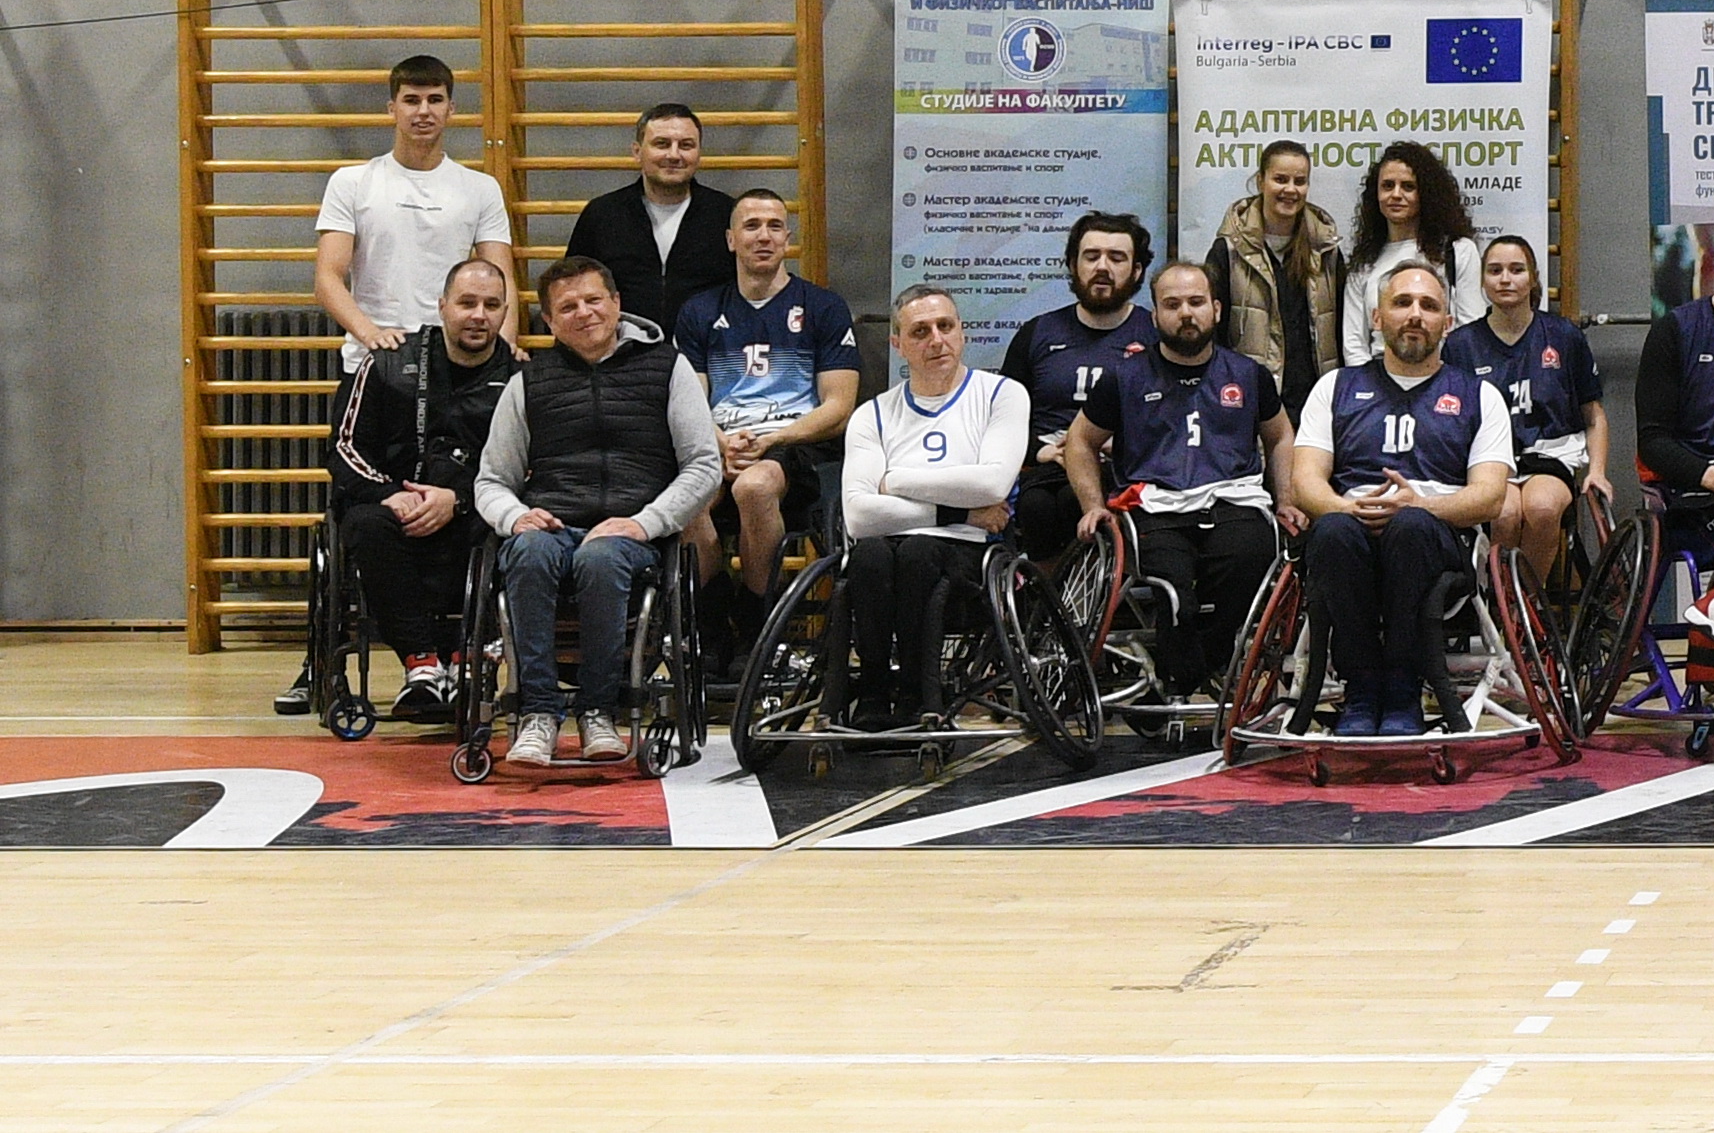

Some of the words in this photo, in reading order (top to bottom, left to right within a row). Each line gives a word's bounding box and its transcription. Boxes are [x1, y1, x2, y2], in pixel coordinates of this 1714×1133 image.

[1197, 35, 1273, 53] Interreg
[1288, 35, 1319, 50] IPA
[1324, 35, 1363, 50] CBC
[1196, 56, 1248, 68] Bulgaria
[1258, 56, 1297, 67] Serbia
[920, 94, 994, 110] СТУДИЈЕ
[998, 95, 1022, 108] НА
[1026, 94, 1126, 109] ФАКУЛТЕТУ
[1194, 109, 1377, 138] АДАПТИВНА
[1386, 107, 1525, 133] ФИЗИЧКА
[925, 147, 980, 159] Основне
[983, 148, 1050, 159] академске
[1053, 148, 1101, 161] студије,
[1195, 142, 1382, 168] АКТНОСТ
[924, 164, 967, 174] физичко
[1034, 164, 1064, 174] спорт
[1464, 176, 1522, 192] МЛАДЕ
[924, 195, 971, 206] Мастер
[974, 195, 1040, 205] академске
[1043, 195, 1092, 207] студије,
[924, 210, 967, 220] физичко
[1033, 211, 1064, 220] спорт
[985, 224, 1020, 234] студије
[923, 256, 970, 267] Мастер
[974, 257, 1041, 267] академске
[923, 271, 966, 281] физичко
[743, 344, 770, 377] 15
[1186, 411, 1200, 446] 5
[1382, 414, 1416, 453] 10
[922, 431, 947, 463] 9
